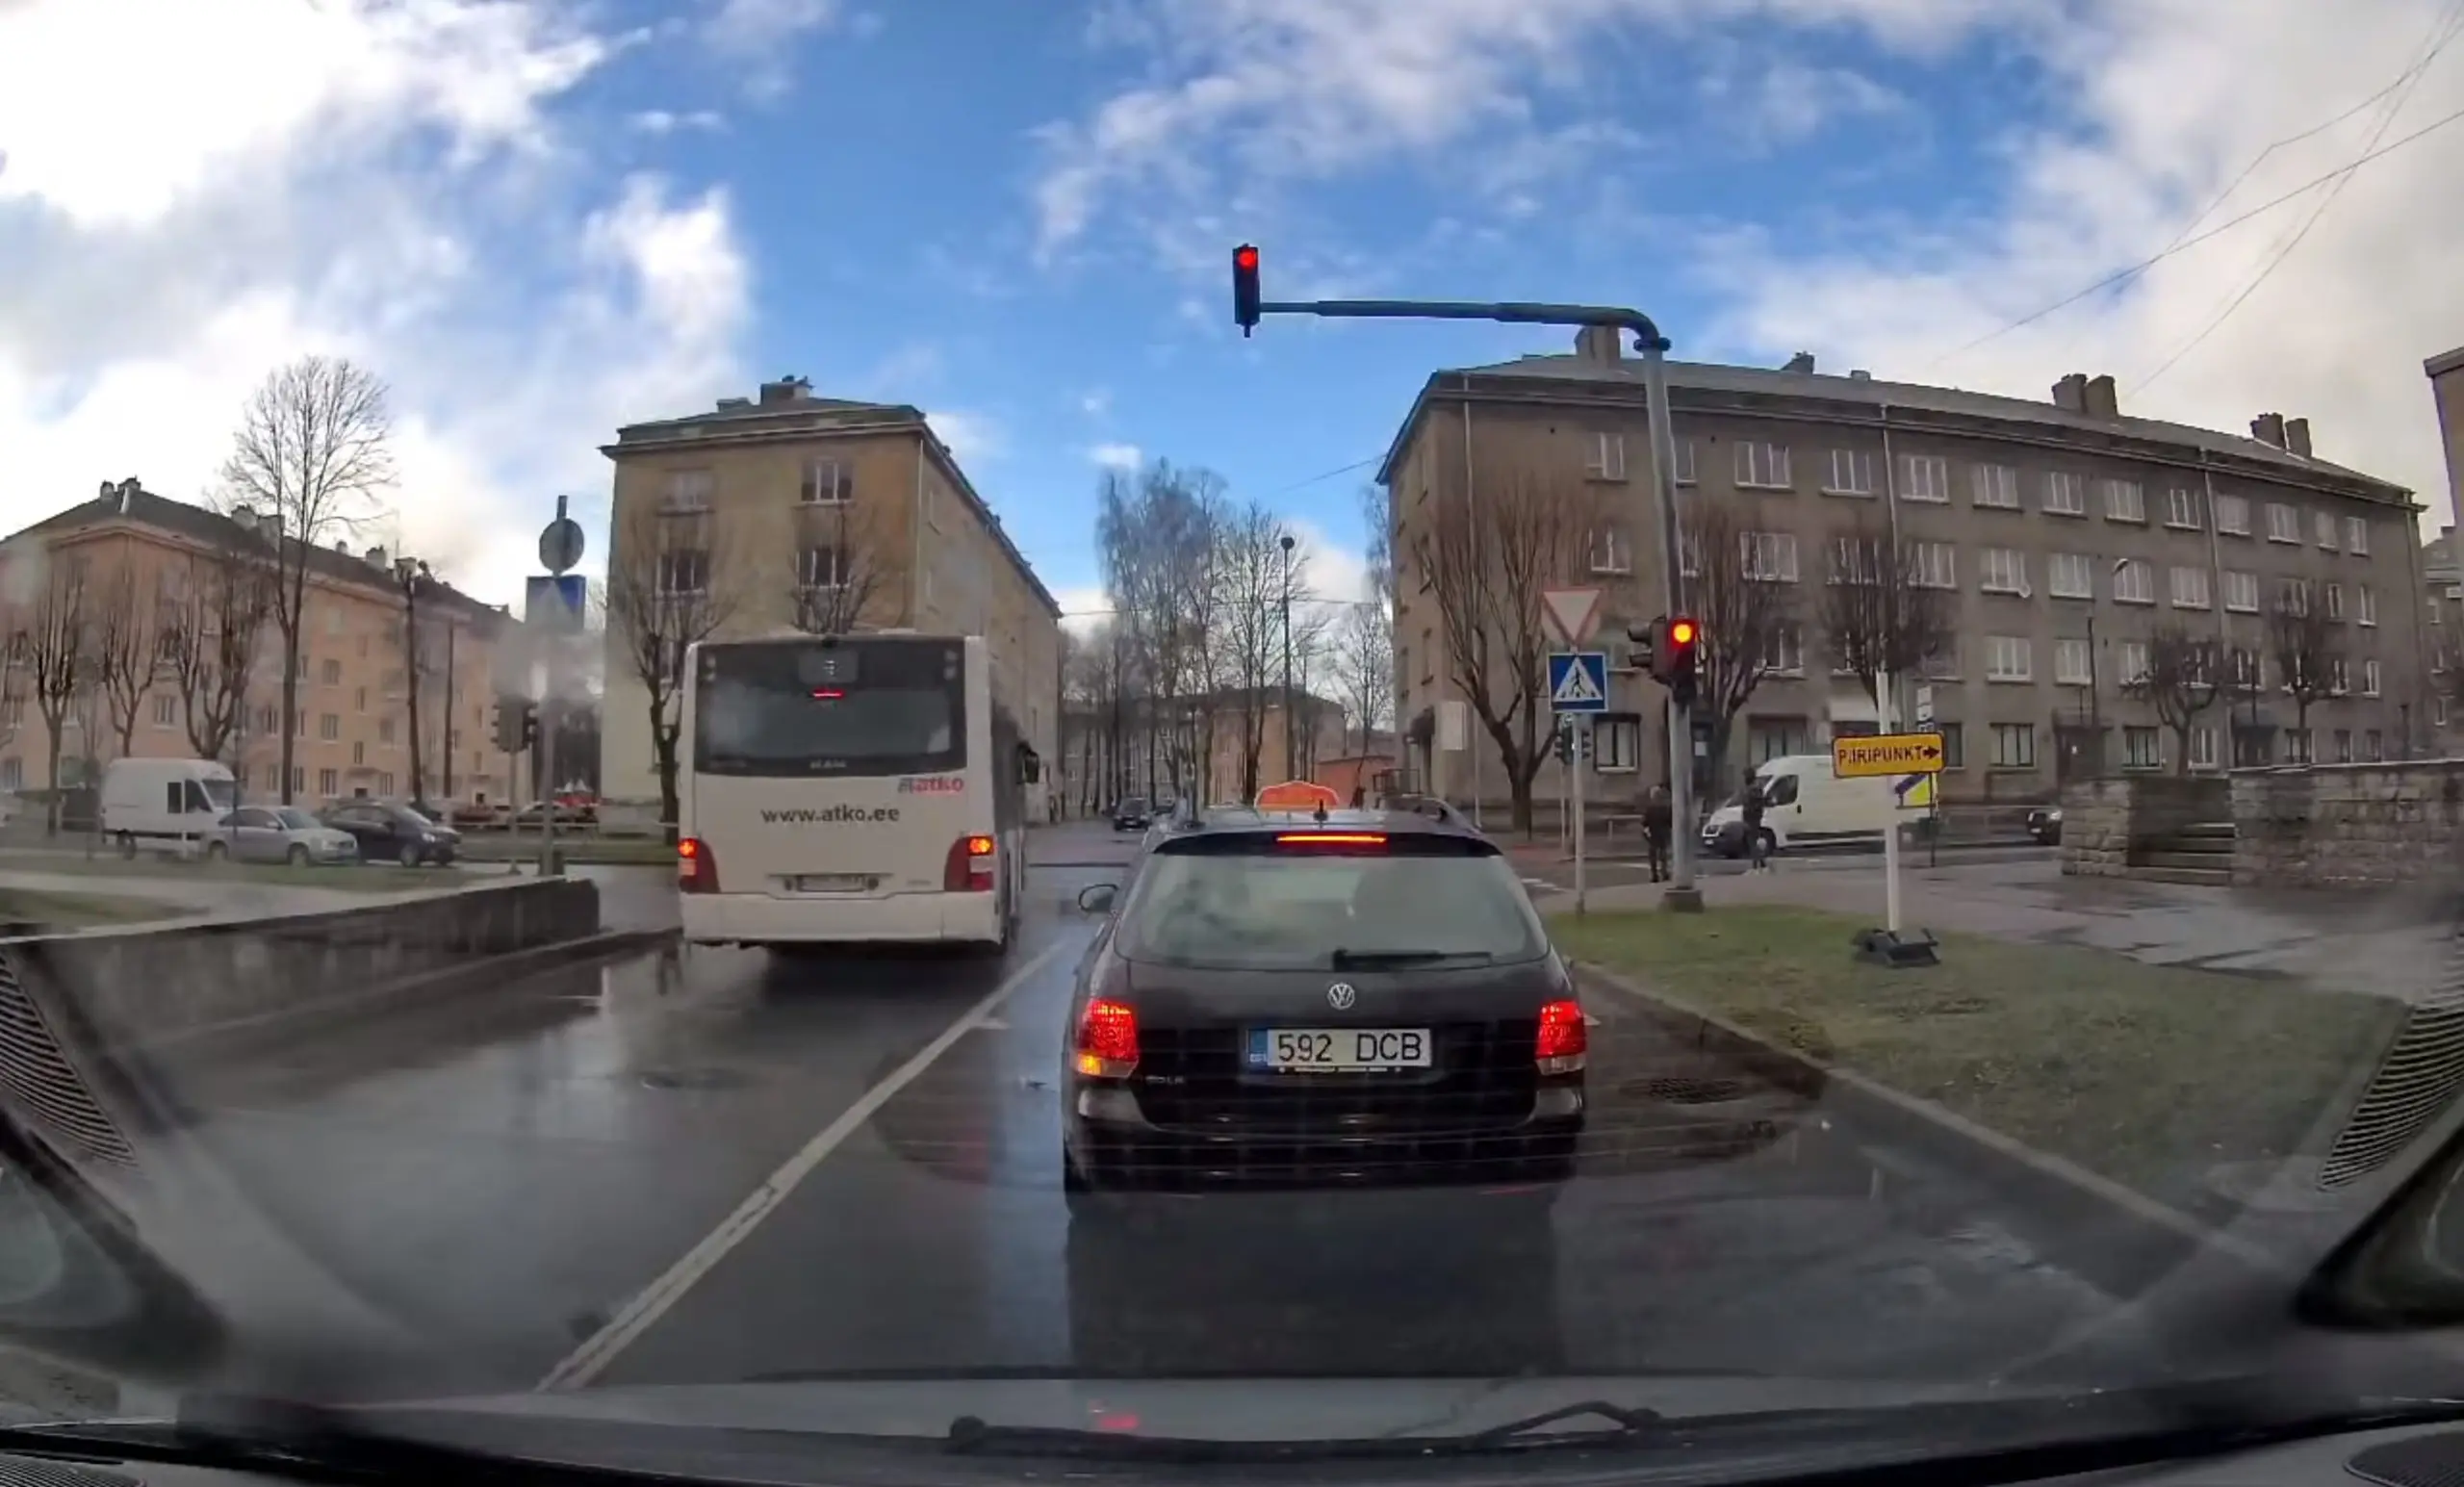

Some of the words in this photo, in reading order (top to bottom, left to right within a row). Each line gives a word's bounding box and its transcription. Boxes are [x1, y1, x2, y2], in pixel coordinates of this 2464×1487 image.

[760, 804, 900, 824] www.atko.ee
[1278, 1033, 1333, 1063] 592
[1356, 1033, 1422, 1063] DCB
